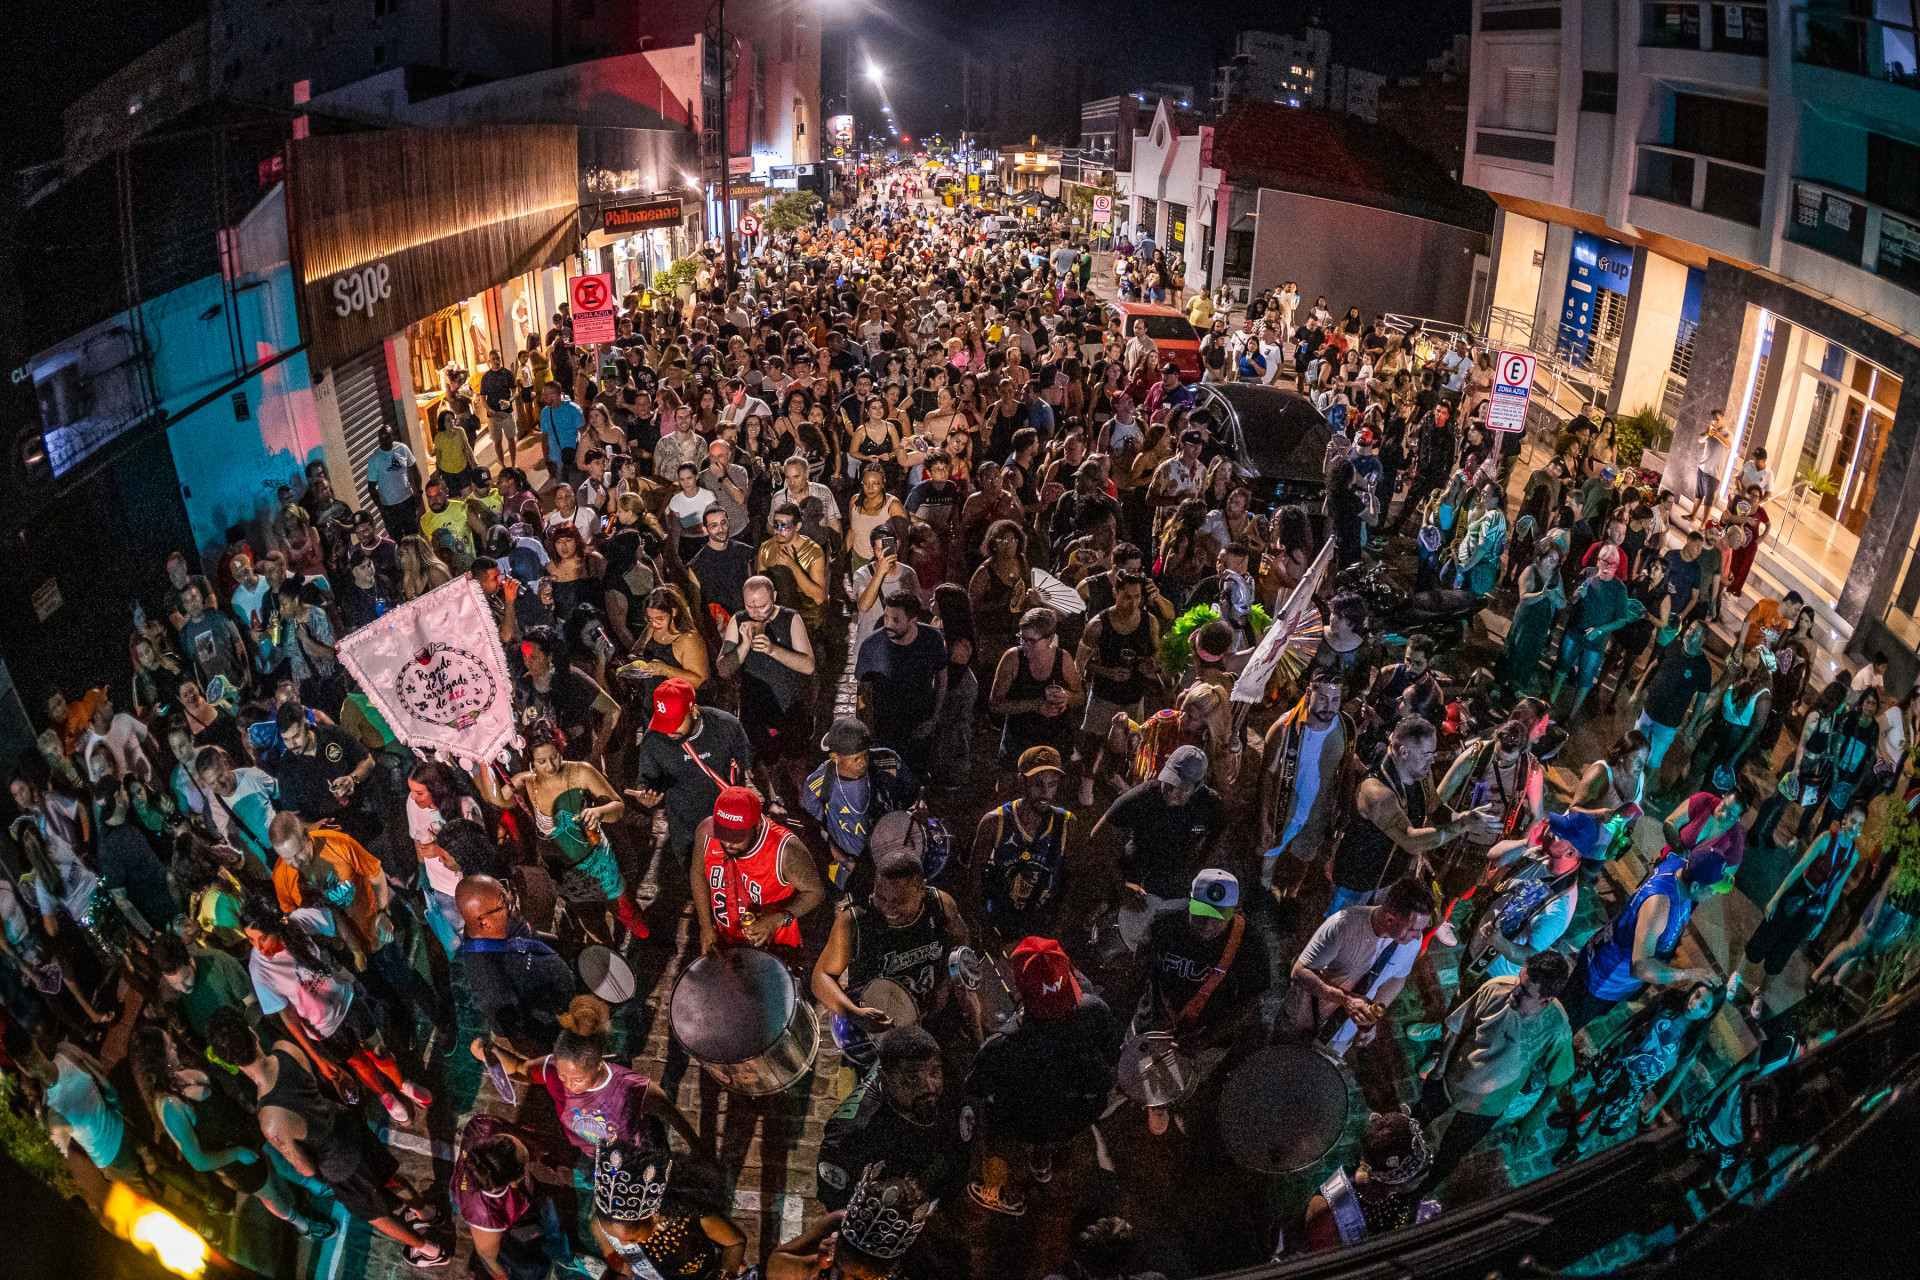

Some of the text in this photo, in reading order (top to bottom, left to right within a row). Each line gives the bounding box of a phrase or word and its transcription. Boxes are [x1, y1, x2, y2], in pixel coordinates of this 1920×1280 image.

[333, 263, 392, 318] sape
[1510, 362, 1521, 380] E
[1497, 385, 1526, 396] ZONA AZUL
[414, 656, 451, 682] Regado
[424, 674, 469, 699] carregado
[425, 679, 436, 691] de
[435, 698, 448, 710] de
